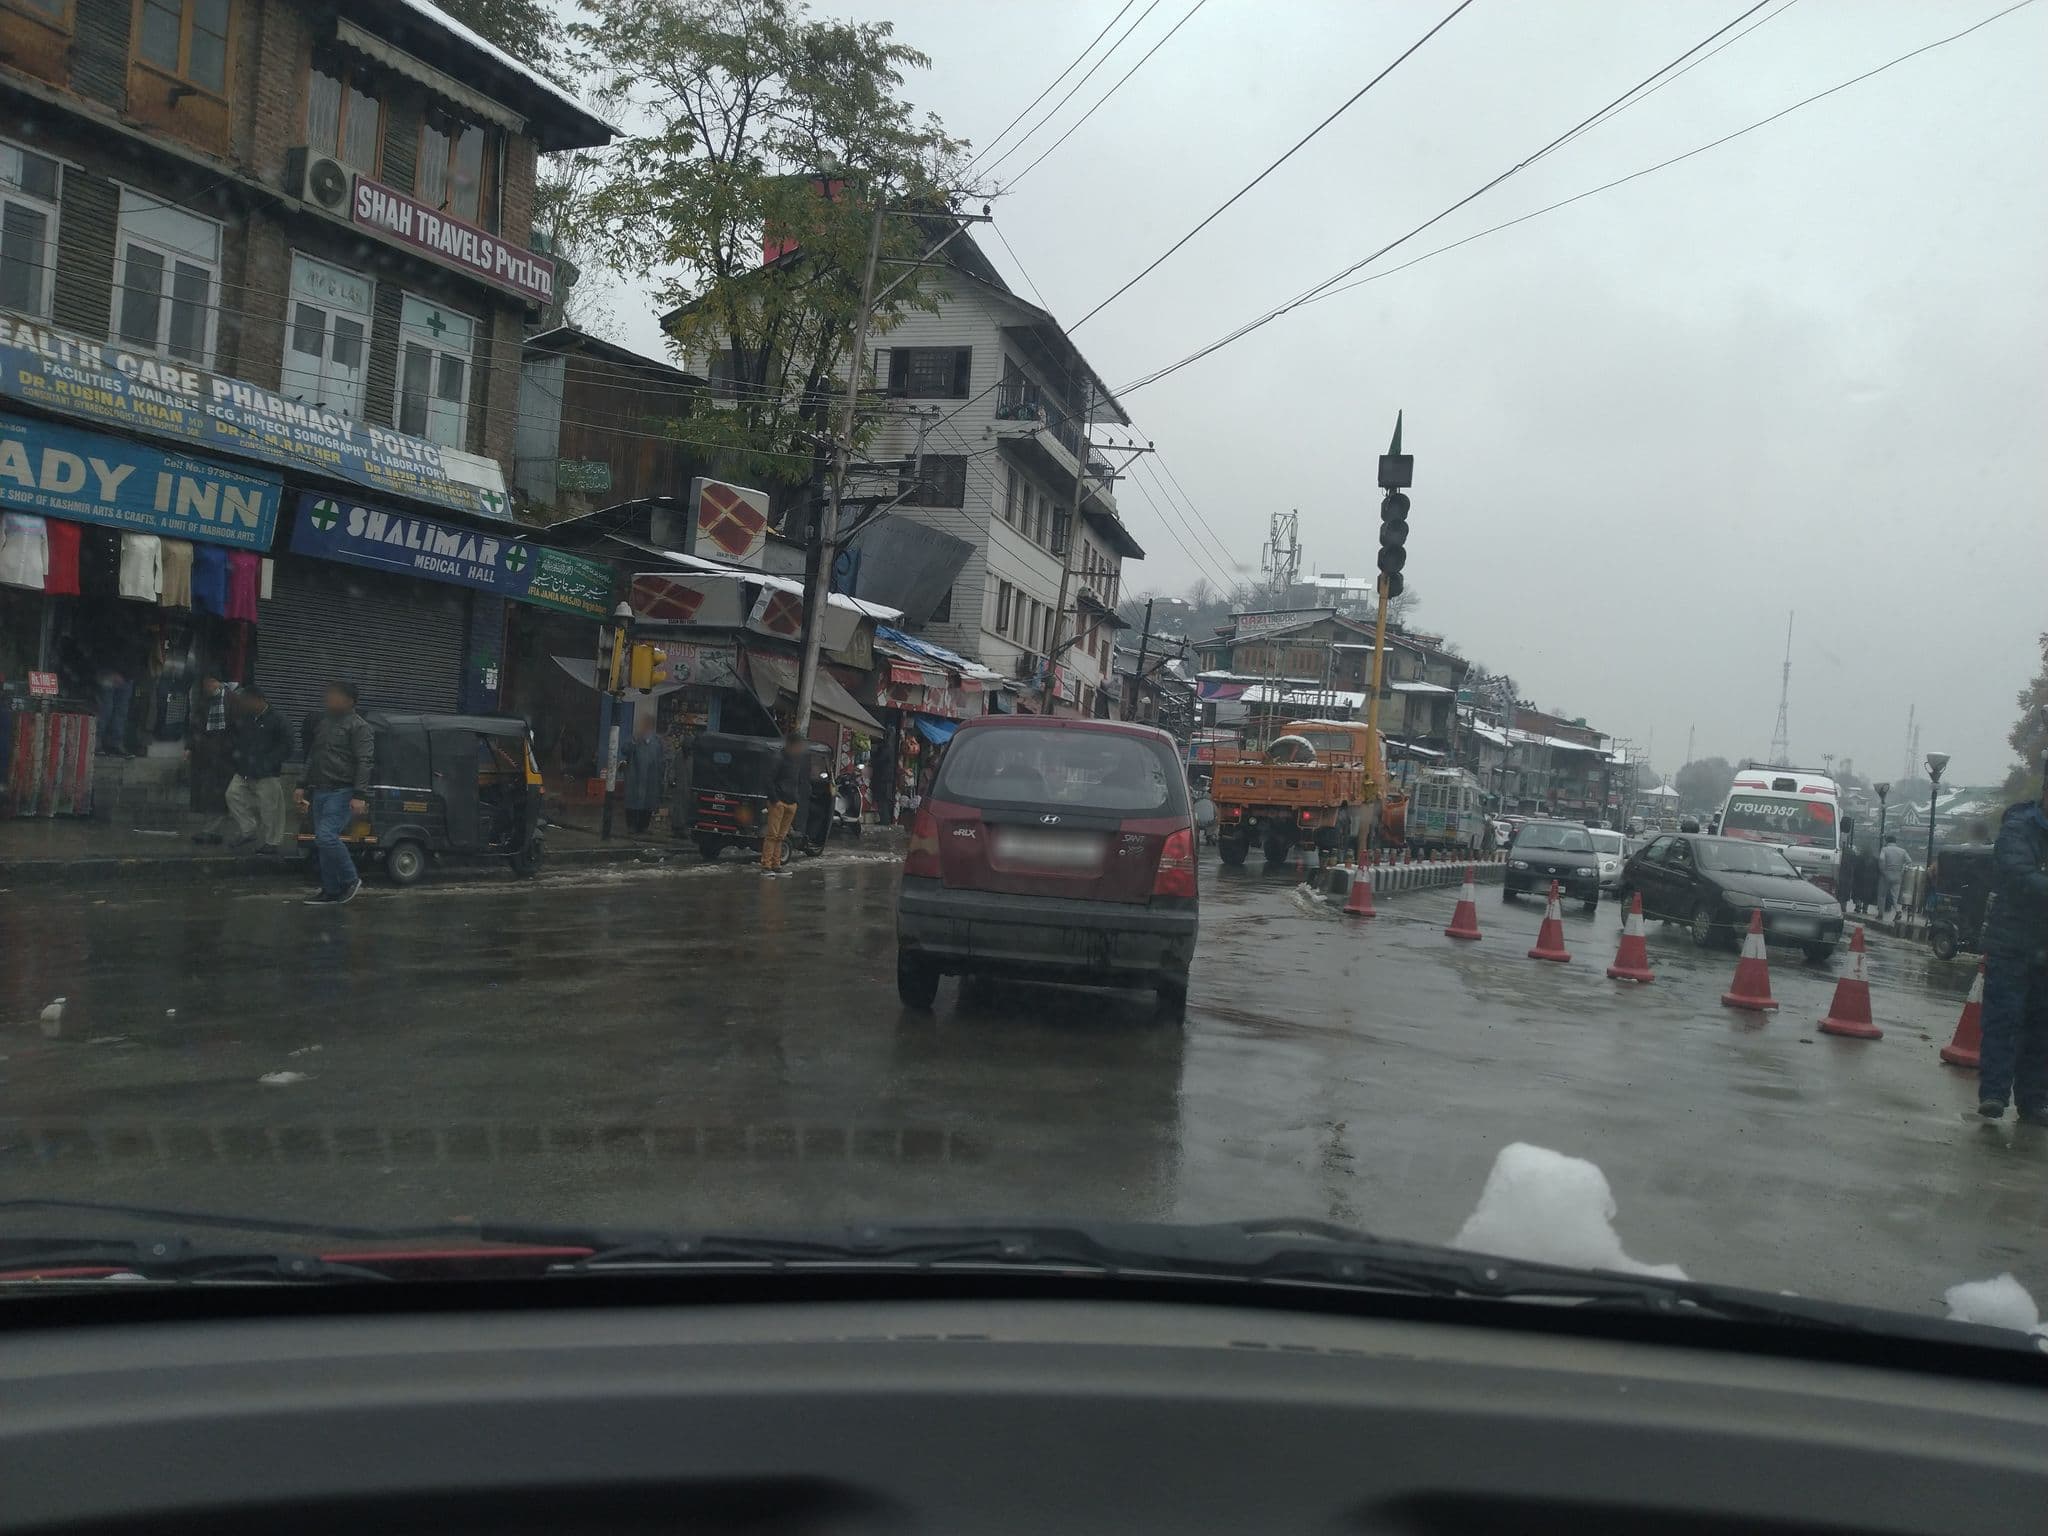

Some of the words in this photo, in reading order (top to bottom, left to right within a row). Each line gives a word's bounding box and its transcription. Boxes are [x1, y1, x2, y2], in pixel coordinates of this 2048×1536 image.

[357, 185, 412, 237] SHAH
[416, 211, 493, 270] TRAVELS
[42, 361, 122, 392] FACILITIES
[128, 384, 200, 412] AVAILABLE
[244, 412, 290, 437] HI-TECH
[294, 428, 368, 458] SONOGRAPHY
[371, 450, 379, 461] &
[116, 354, 200, 397] CARE
[212, 378, 353, 441] PHARMACY
[133, 400, 183, 423] KHAN
[188, 416, 204, 430] MD
[7, 489, 34, 504] SHOP
[36, 494, 49, 507] OF
[49, 496, 91, 515] KASHMIR
[92, 504, 115, 519] ARTS
[115, 508, 124, 520] &
[160, 518, 168, 528] A
[168, 519, 187, 532] UNIT
[188, 522, 199, 533] OF
[236, 530, 256, 542] ARTS
[153, 471, 263, 529] INN
[346, 506, 500, 566] SHALIMAR
[414, 554, 462, 578] MEDICAL
[467, 565, 495, 583] HALL
[1240, 615, 1267, 625] QAZI
[1733, 802, 1799, 817] TOURIST
